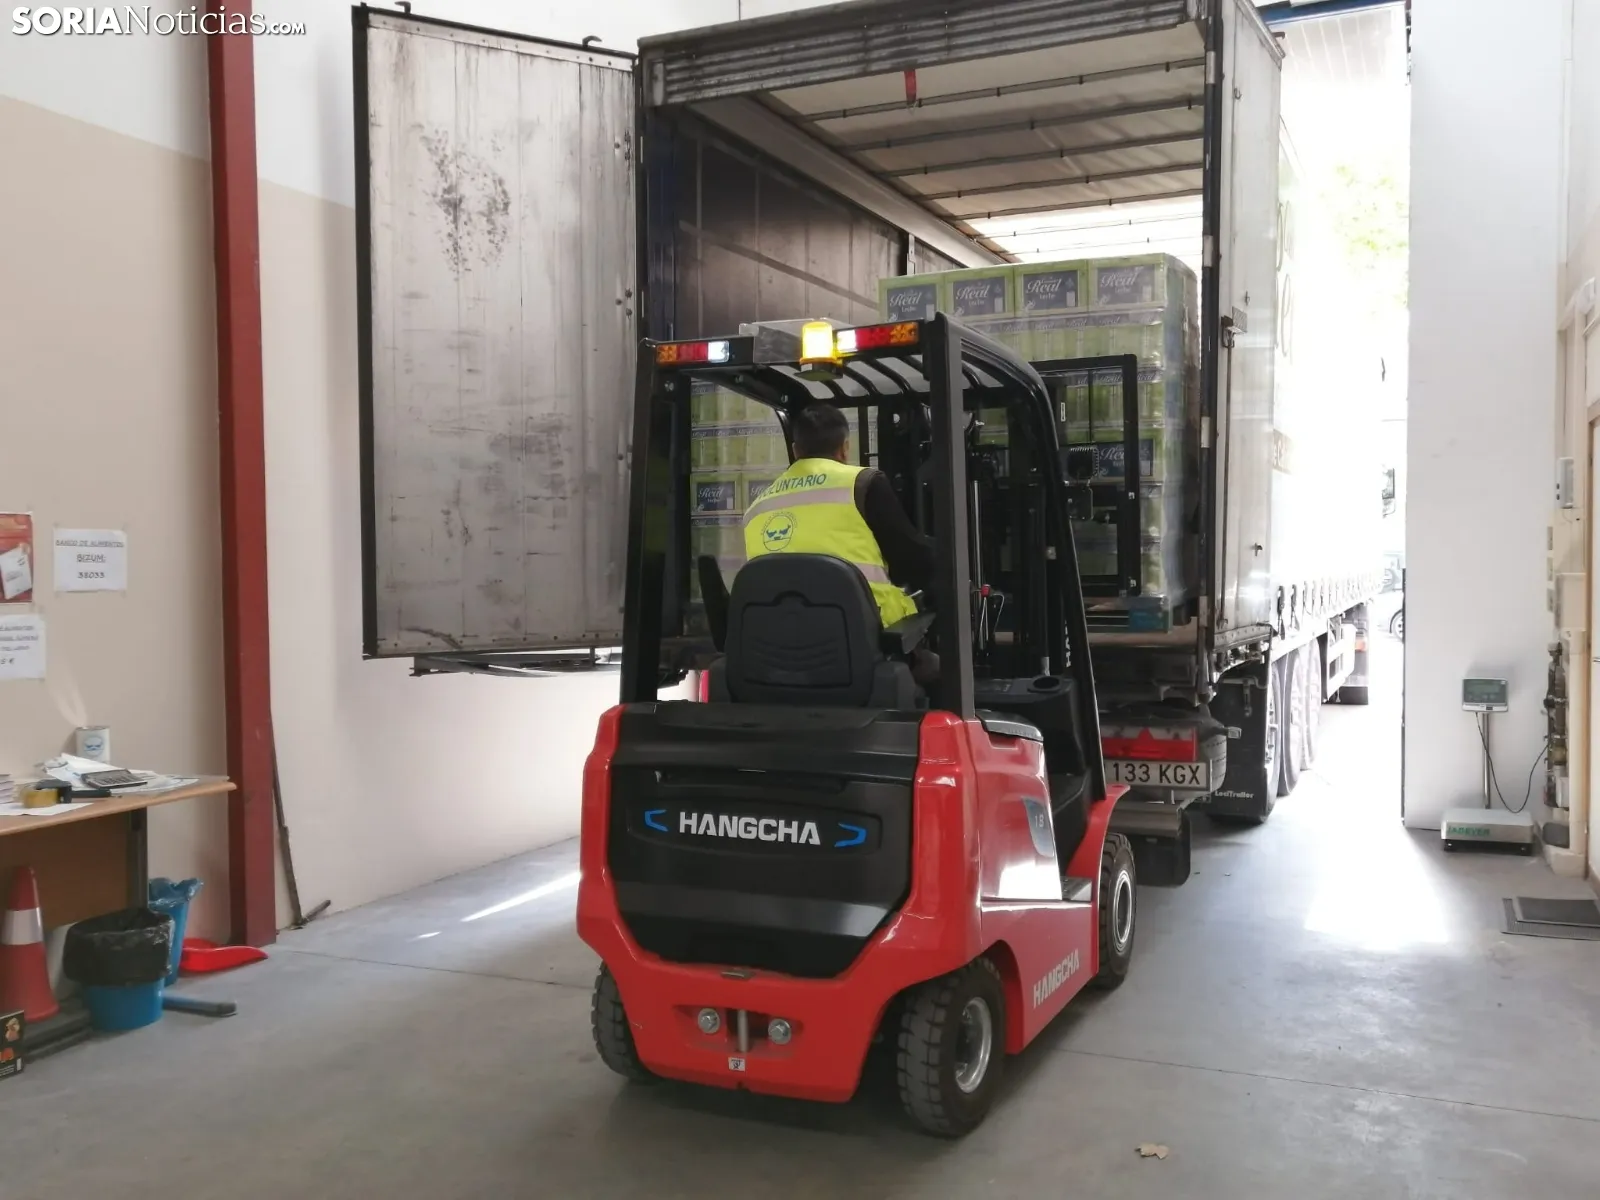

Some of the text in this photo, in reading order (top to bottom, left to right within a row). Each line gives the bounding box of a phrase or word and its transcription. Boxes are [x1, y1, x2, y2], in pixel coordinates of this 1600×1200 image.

[955, 284, 990, 300] Real
[1026, 278, 1062, 293] Real
[890, 292, 922, 307] Real
[763, 473, 827, 500] LUNTARIO
[1104, 763, 1201, 785] 133 KGX
[679, 811, 821, 846] HANGCHA
[1033, 948, 1080, 1010] HANGCHA
